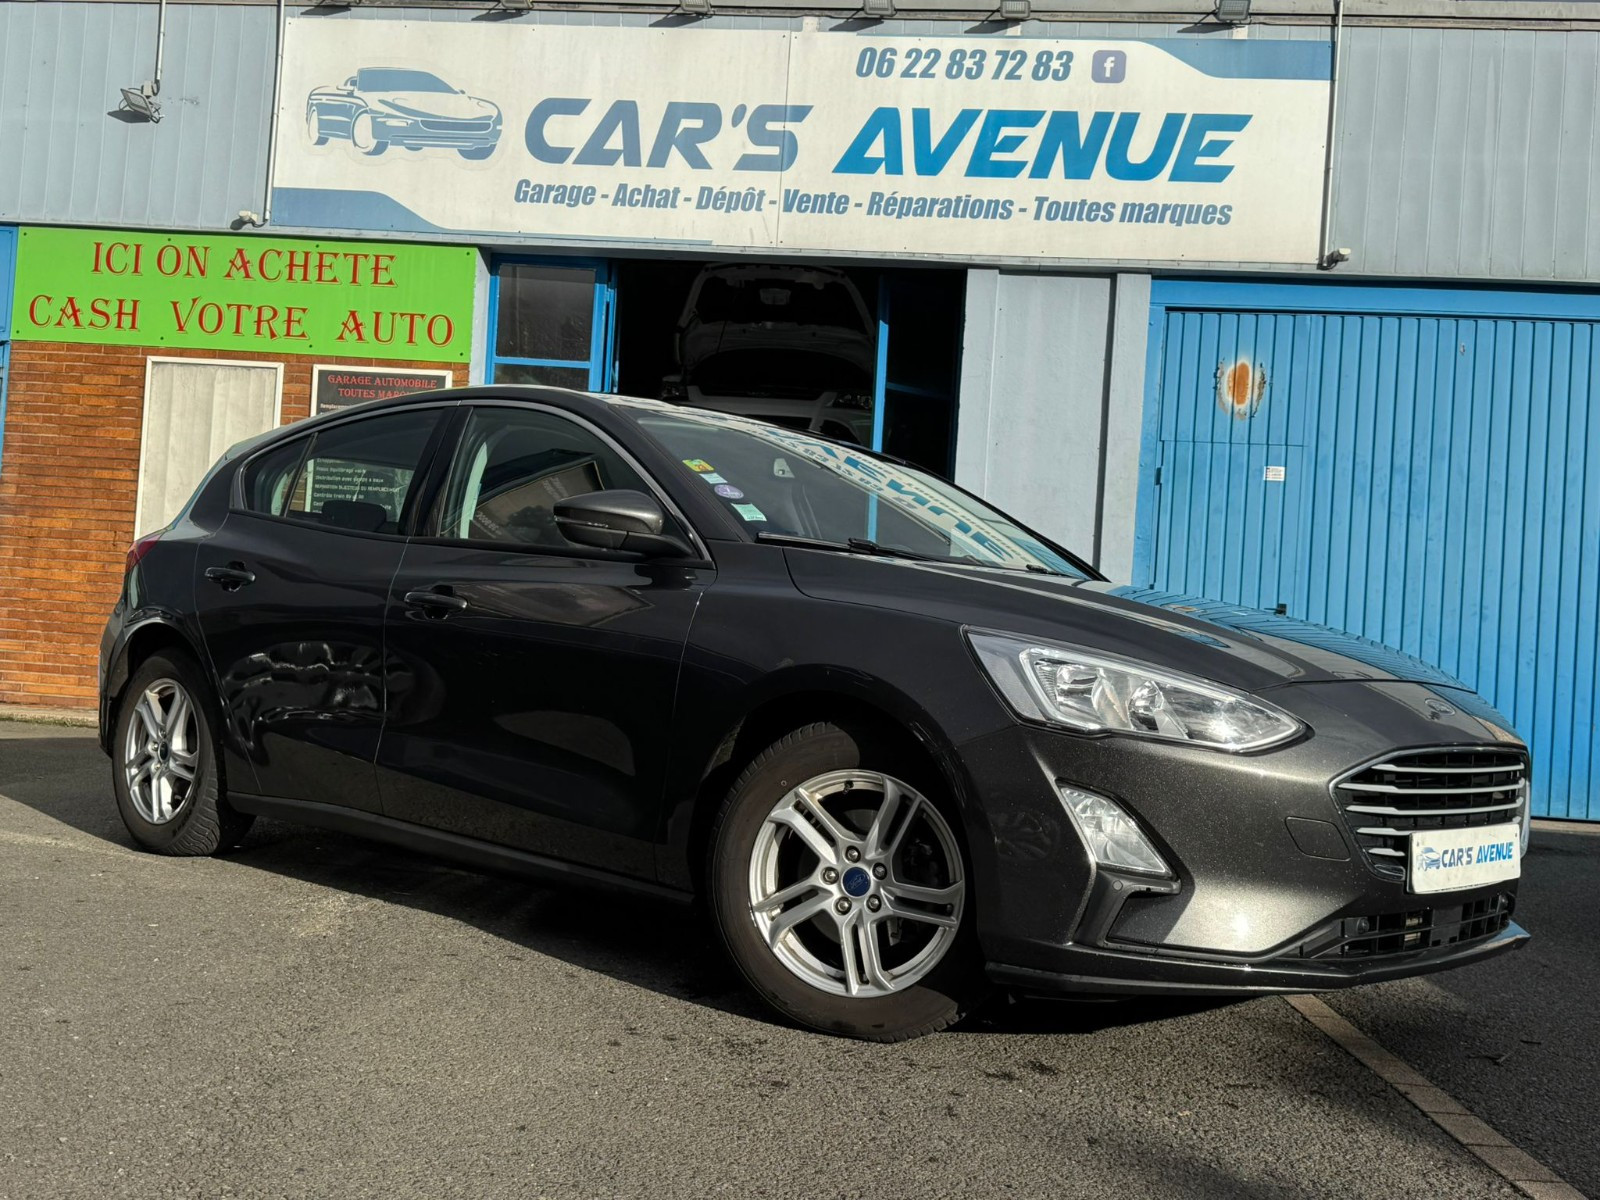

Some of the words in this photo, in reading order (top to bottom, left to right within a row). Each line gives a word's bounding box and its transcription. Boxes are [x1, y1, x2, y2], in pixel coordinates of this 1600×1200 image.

[856, 47, 898, 79] 06
[900, 48, 942, 79] 22
[945, 49, 986, 80] 83
[991, 50, 1028, 80] 72
[1031, 51, 1074, 82] 83
[525, 97, 814, 172] CAR'S
[831, 106, 1253, 183] AVENUE
[514, 179, 596, 208] Garage
[612, 182, 682, 210] Achat
[695, 186, 766, 214] Dépôt
[782, 188, 850, 216] Vente
[866, 191, 1016, 221] Réparations
[1032, 196, 1116, 224] Toutes
[1119, 202, 1233, 227] marques
[92, 242, 143, 275] ICI
[157, 244, 209, 278] ON
[225, 248, 397, 287] ACHETE
[29, 295, 140, 331] CASH
[171, 297, 308, 341] VOTRE
[336, 310, 454, 347] AUTO
[327, 375, 372, 386] GARAGE
[374, 377, 438, 390] AUTOMOBILE
[338, 388, 376, 399] TOUTES
[1441, 846, 1473, 868] CAR'S
[1476, 841, 1514, 864] AVENUE
